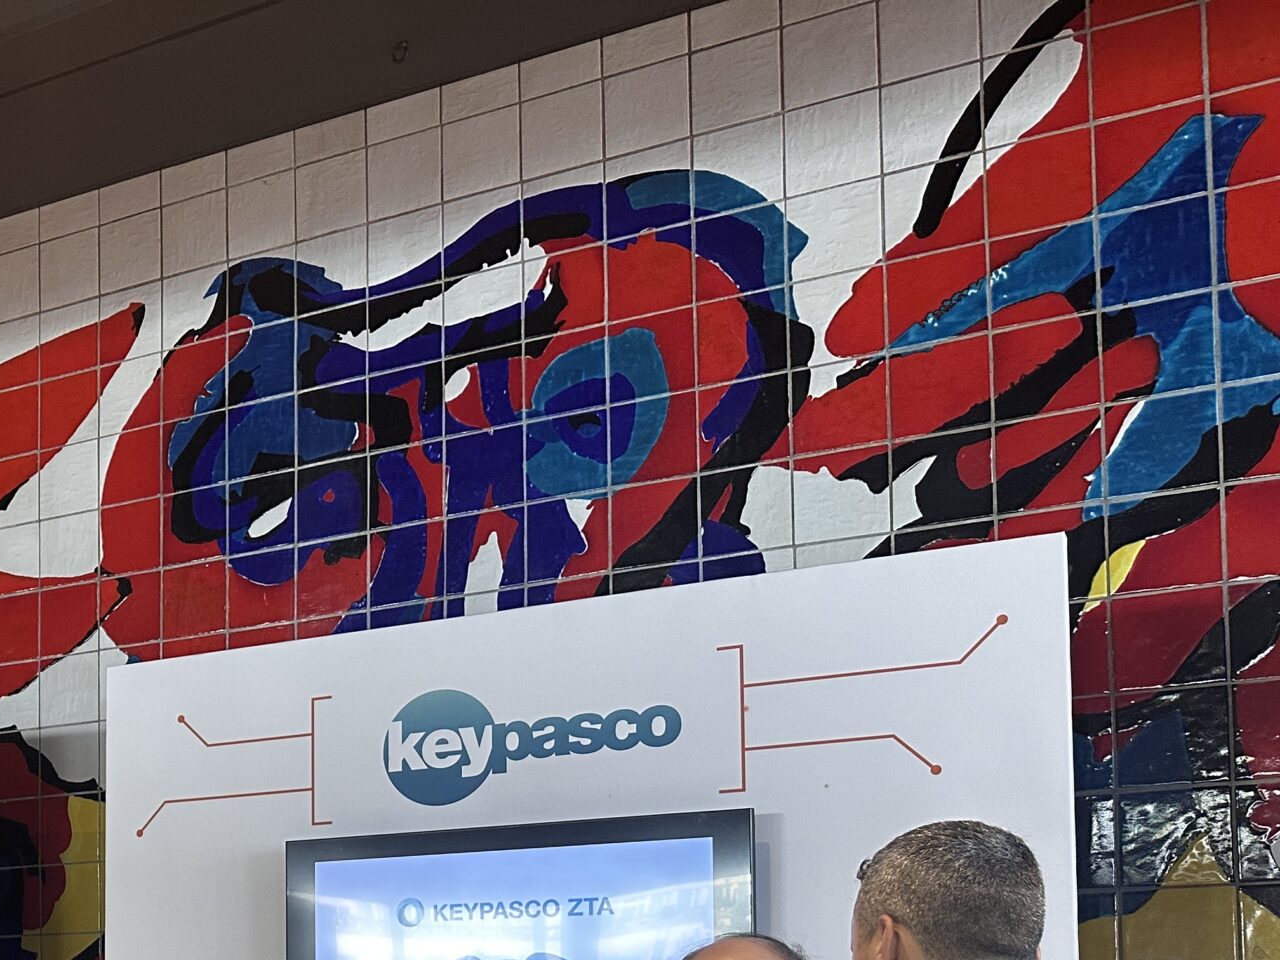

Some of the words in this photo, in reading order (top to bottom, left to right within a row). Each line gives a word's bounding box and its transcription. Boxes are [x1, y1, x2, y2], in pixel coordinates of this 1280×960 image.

[387, 704, 682, 778] keypasco
[433, 899, 560, 922] KEYPASCO
[567, 896, 615, 917] ZTA
